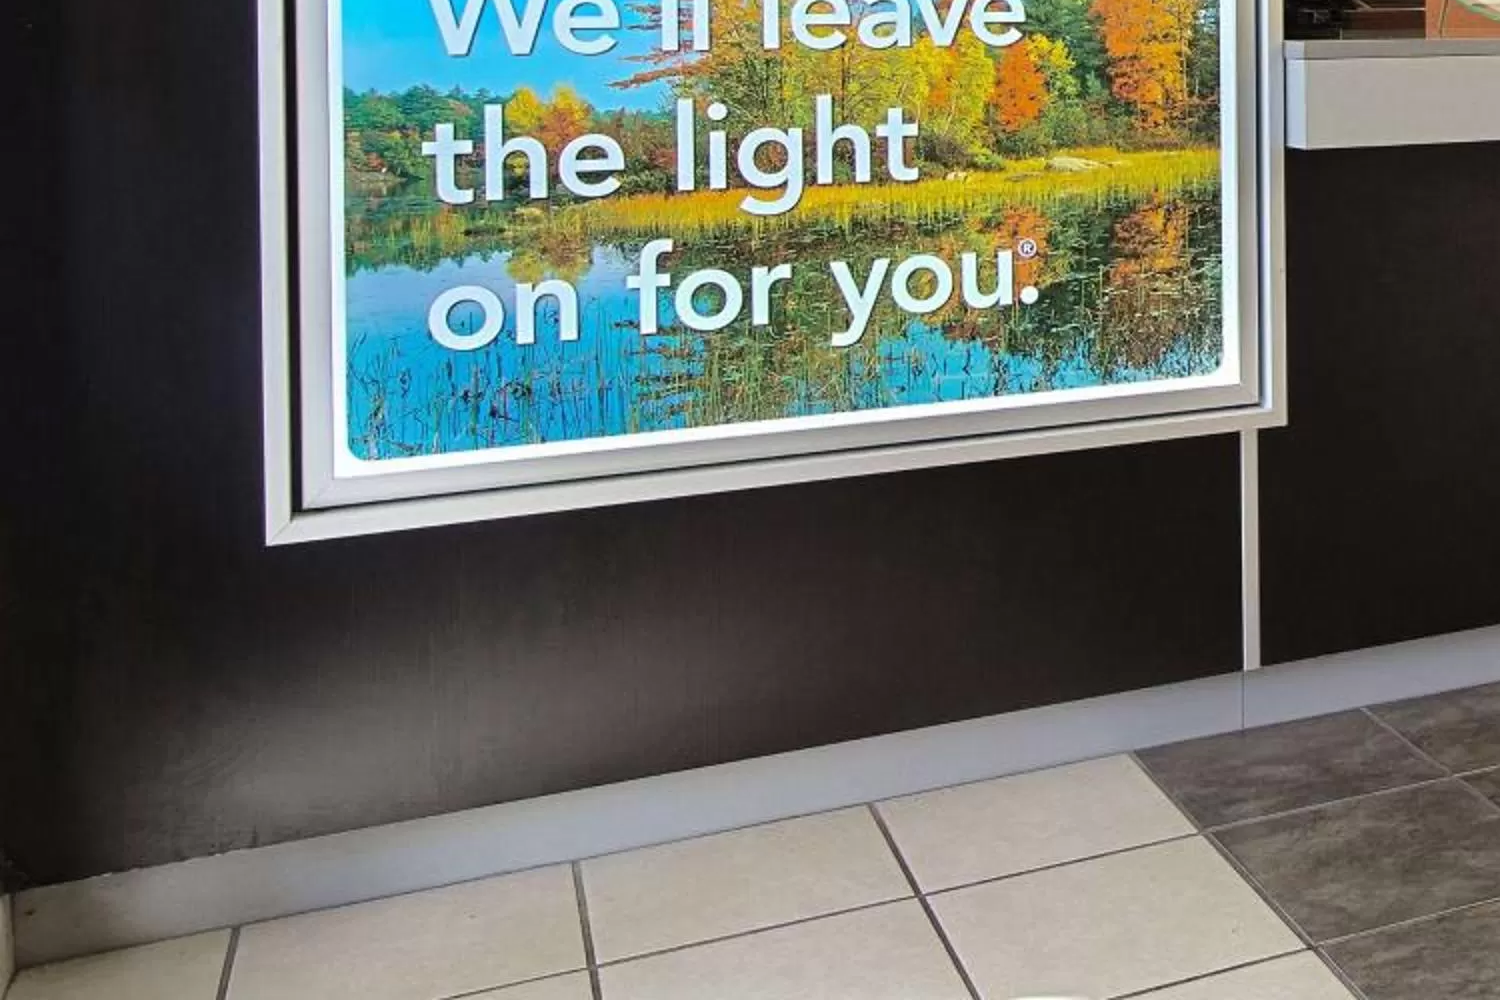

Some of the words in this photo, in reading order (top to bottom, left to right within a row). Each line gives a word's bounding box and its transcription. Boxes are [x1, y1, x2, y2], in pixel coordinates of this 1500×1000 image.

[421, 103, 625, 205] the
[675, 94, 920, 216] light
[428, 276, 579, 352] on
[627, 239, 792, 337] for
